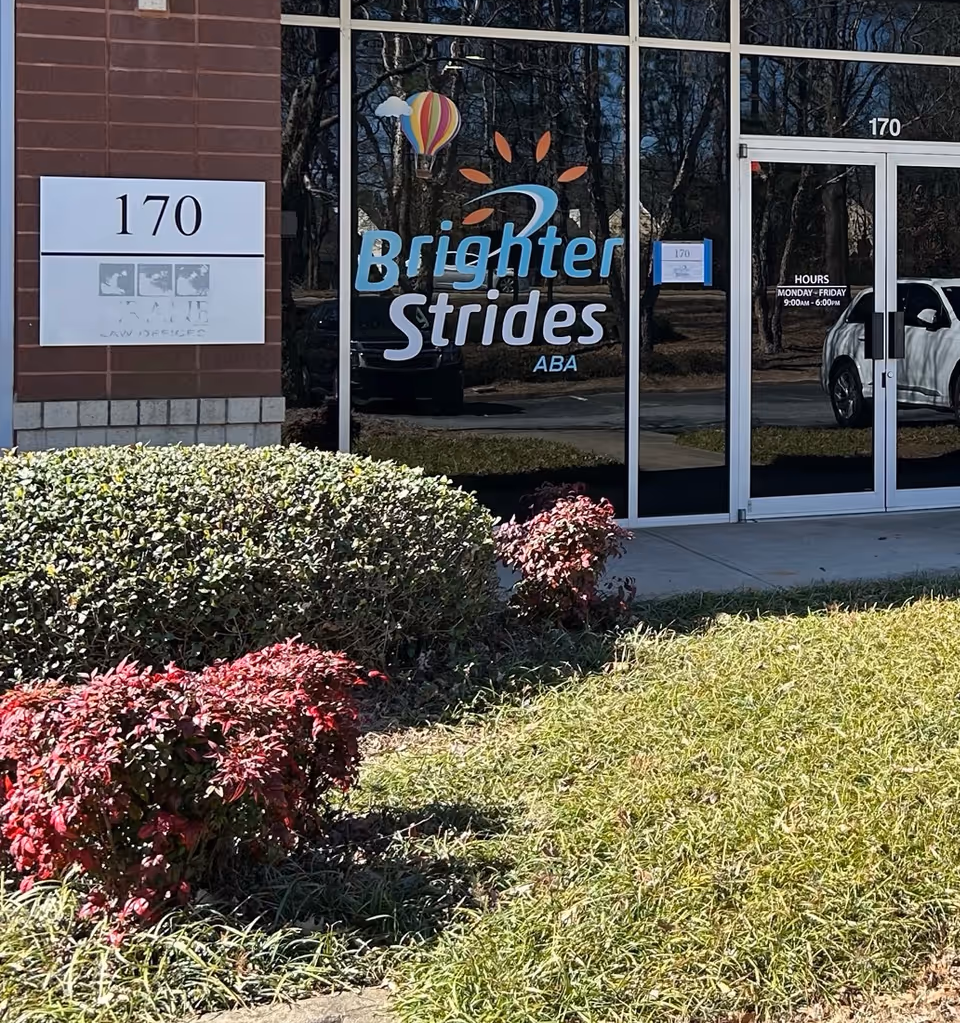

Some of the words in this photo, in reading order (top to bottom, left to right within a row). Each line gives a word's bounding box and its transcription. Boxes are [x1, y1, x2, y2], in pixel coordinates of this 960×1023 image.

[869, 117, 901, 136] 170
[116, 193, 202, 237] 170
[355, 220, 625, 292] Brighter
[675, 248, 690, 258] 170
[794, 274, 830, 284] HOURS
[777, 288, 813, 297] MONDAY
[819, 288, 847, 297] FRIDAY
[783, 299, 810, 307] 9:00AM
[815, 299, 841, 307] 6:00PM
[383, 288, 607, 361] Strides
[533, 355, 578, 373] ABA
